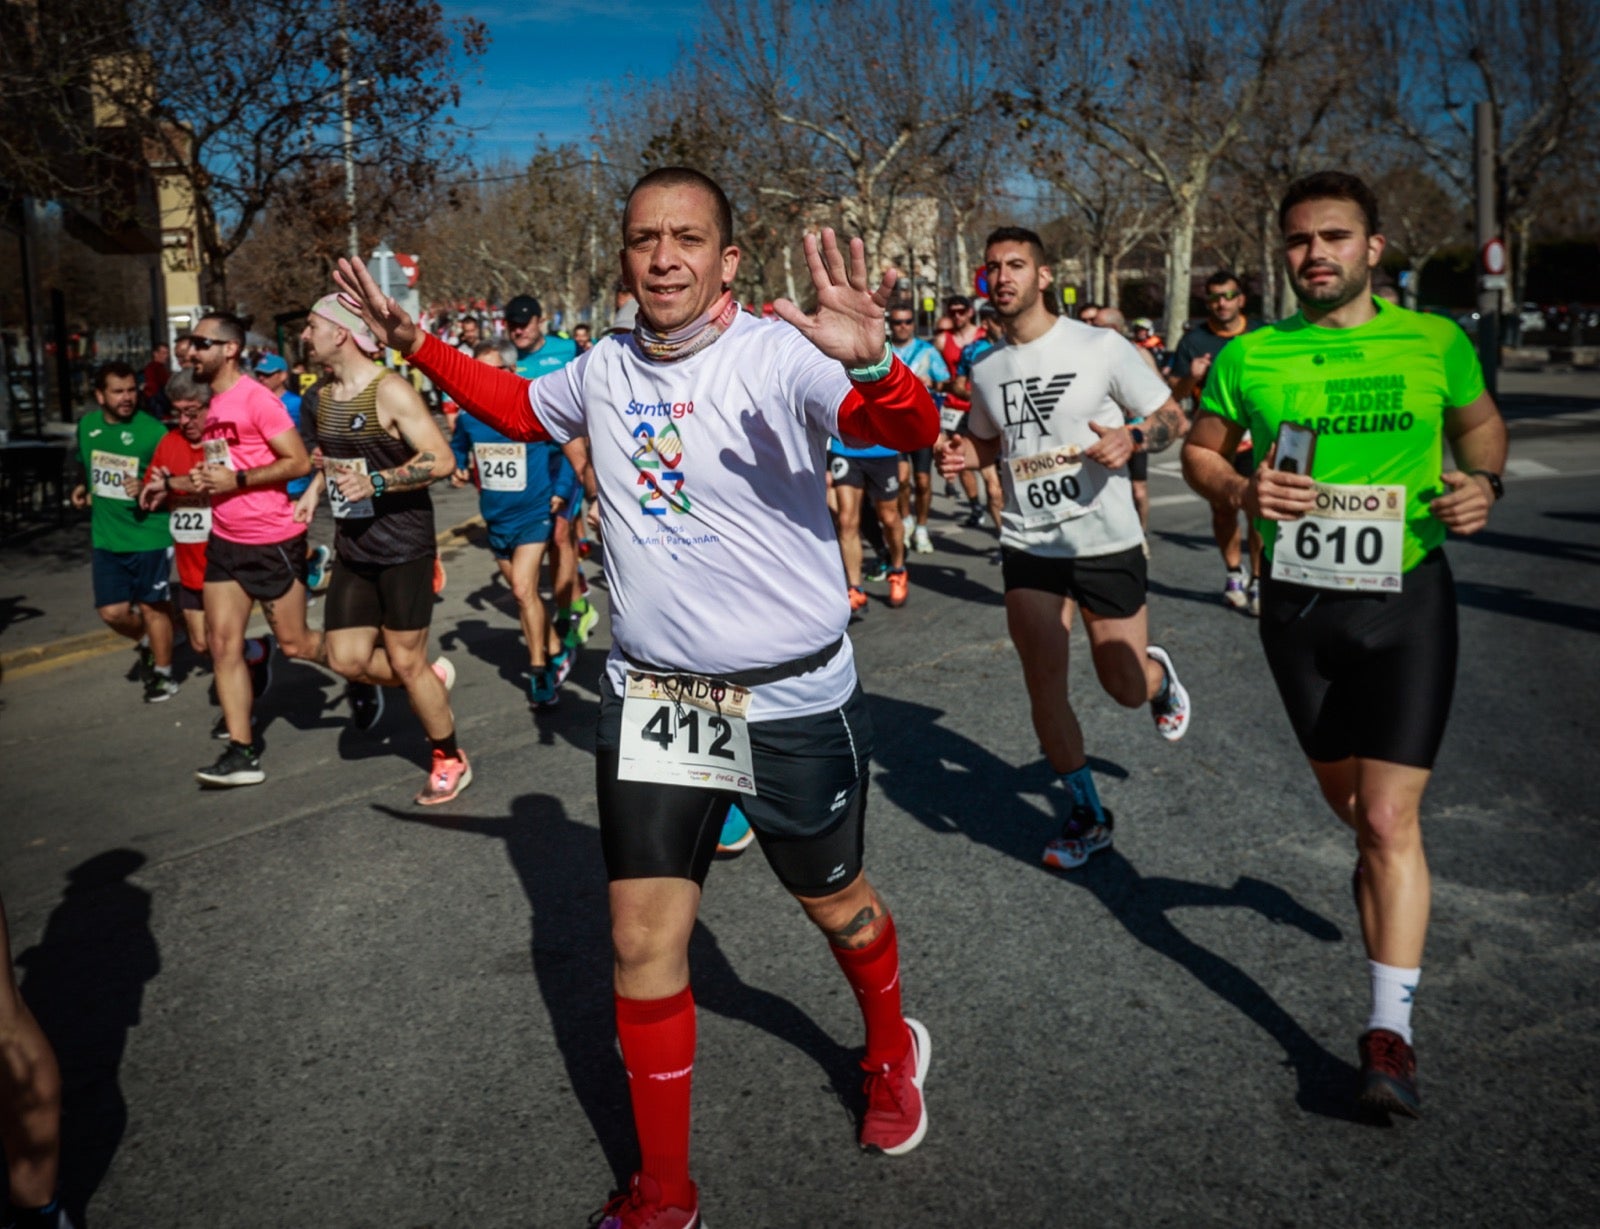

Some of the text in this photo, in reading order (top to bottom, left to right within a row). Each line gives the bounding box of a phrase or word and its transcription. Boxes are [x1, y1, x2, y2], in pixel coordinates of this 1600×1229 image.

[1324, 374, 1407, 394] MEMORIAL
[1326, 391, 1404, 415] PADRE
[1288, 411, 1414, 435] ARCELINO
[483, 460, 517, 478] 246
[1027, 475, 1080, 509] 680
[1314, 492, 1380, 512] ONDO
[174, 513, 204, 530] 222
[1295, 521, 1383, 565] 610
[641, 706, 735, 760] 412
